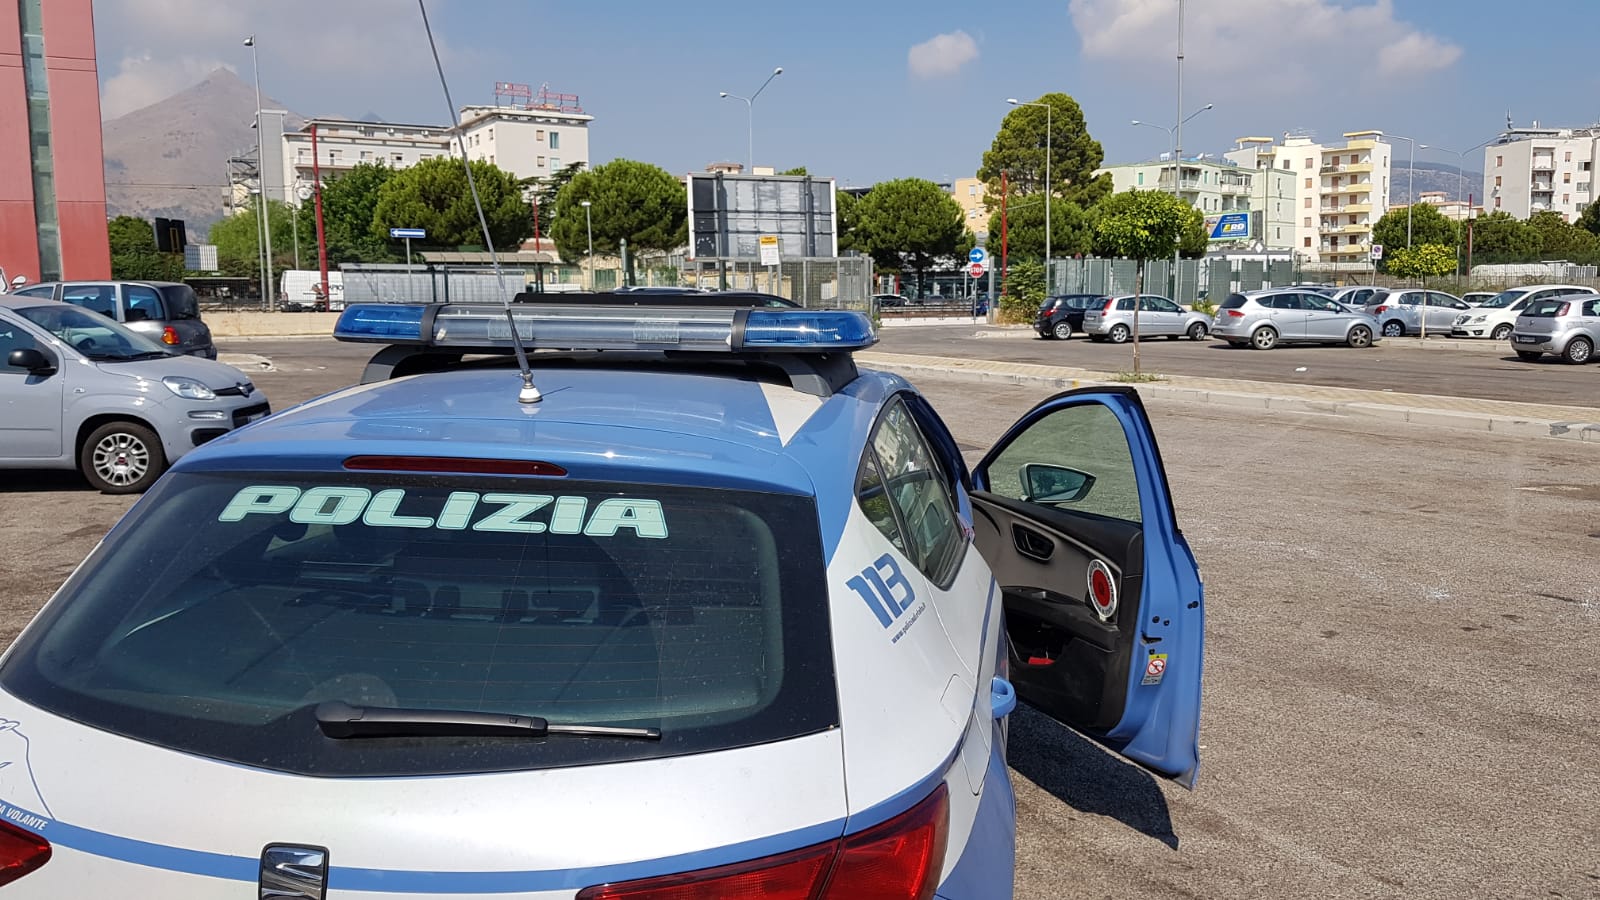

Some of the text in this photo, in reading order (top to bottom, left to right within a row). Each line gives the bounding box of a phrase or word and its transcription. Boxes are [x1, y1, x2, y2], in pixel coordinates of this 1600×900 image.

[217, 485, 669, 539] POLIZIA
[845, 553, 915, 629] 113
[6, 808, 48, 831] VOLANTE
